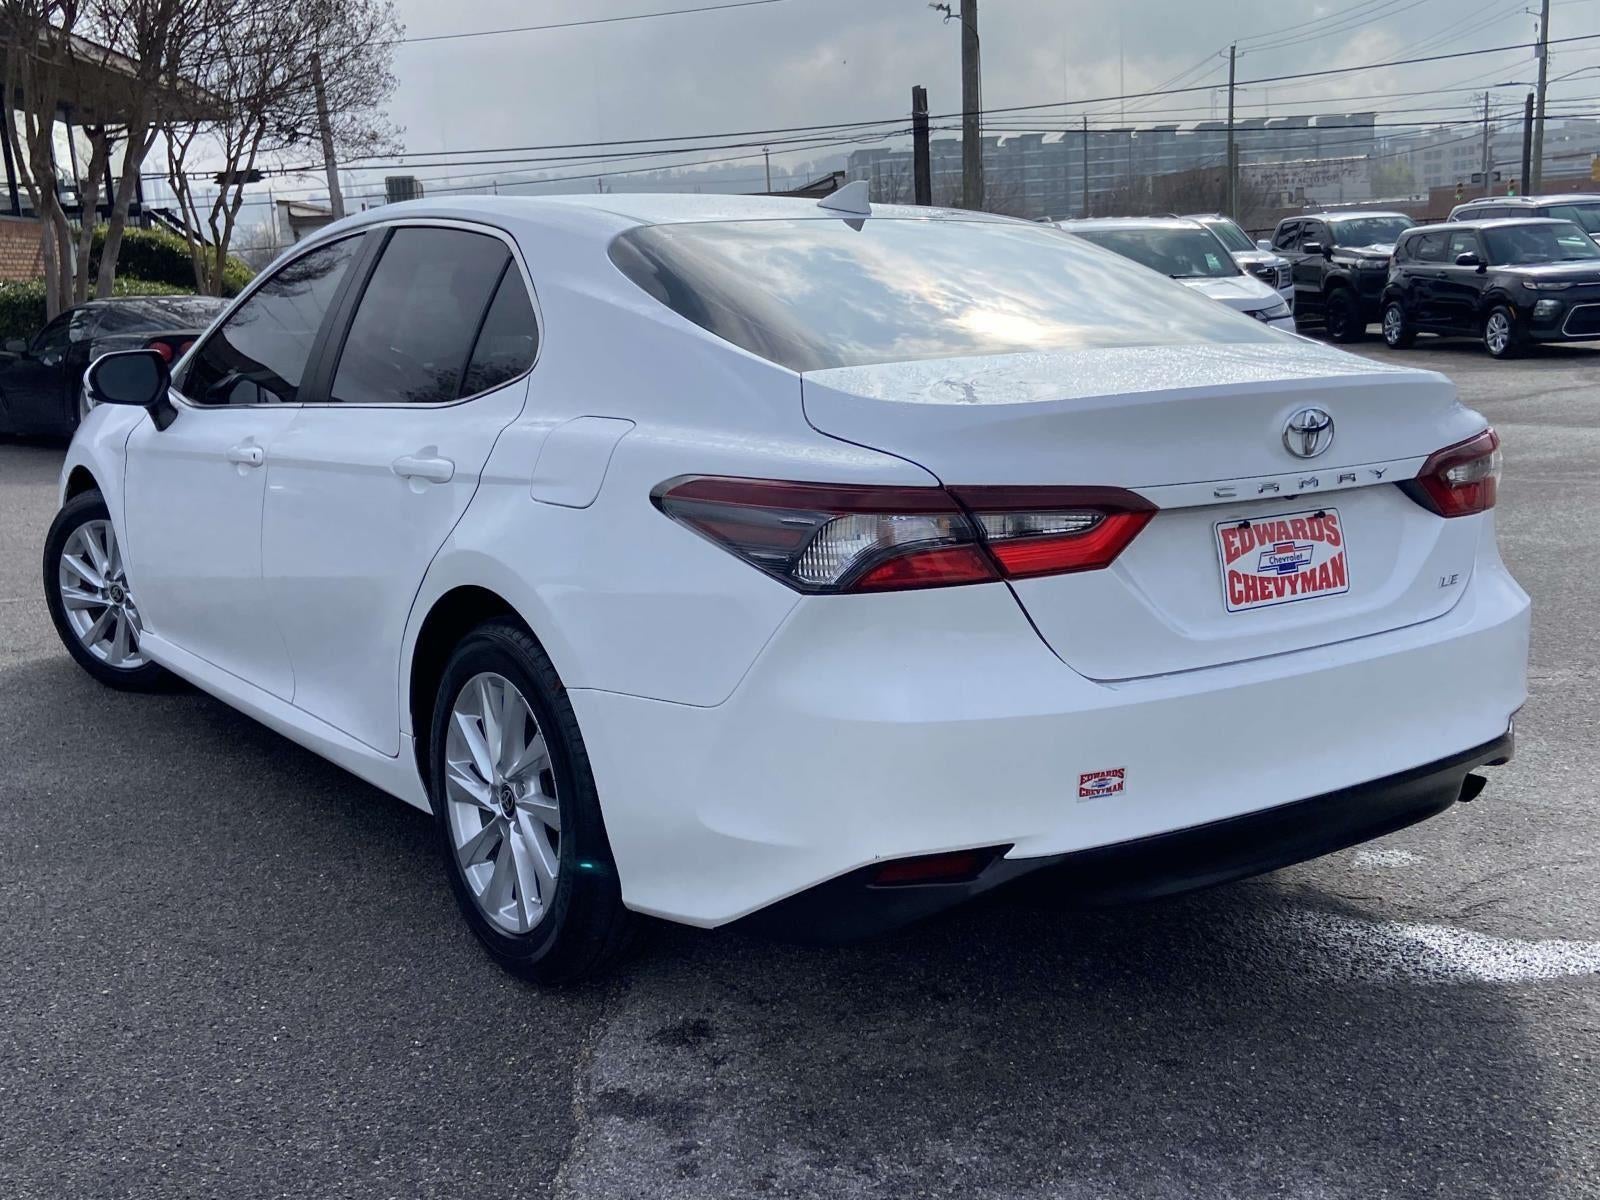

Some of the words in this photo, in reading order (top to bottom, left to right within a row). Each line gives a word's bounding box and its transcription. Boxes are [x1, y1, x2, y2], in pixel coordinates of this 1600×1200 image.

[1214, 467, 1387, 497] CAMRY
[1220, 514, 1341, 566] EDWARDS
[1269, 552, 1303, 565] Chevrolet
[1228, 551, 1345, 605] CHEVYMAN
[1439, 573, 1459, 588] LE
[1080, 768, 1125, 785] EDWARDS
[1079, 780, 1123, 797] CHEVYMAN
